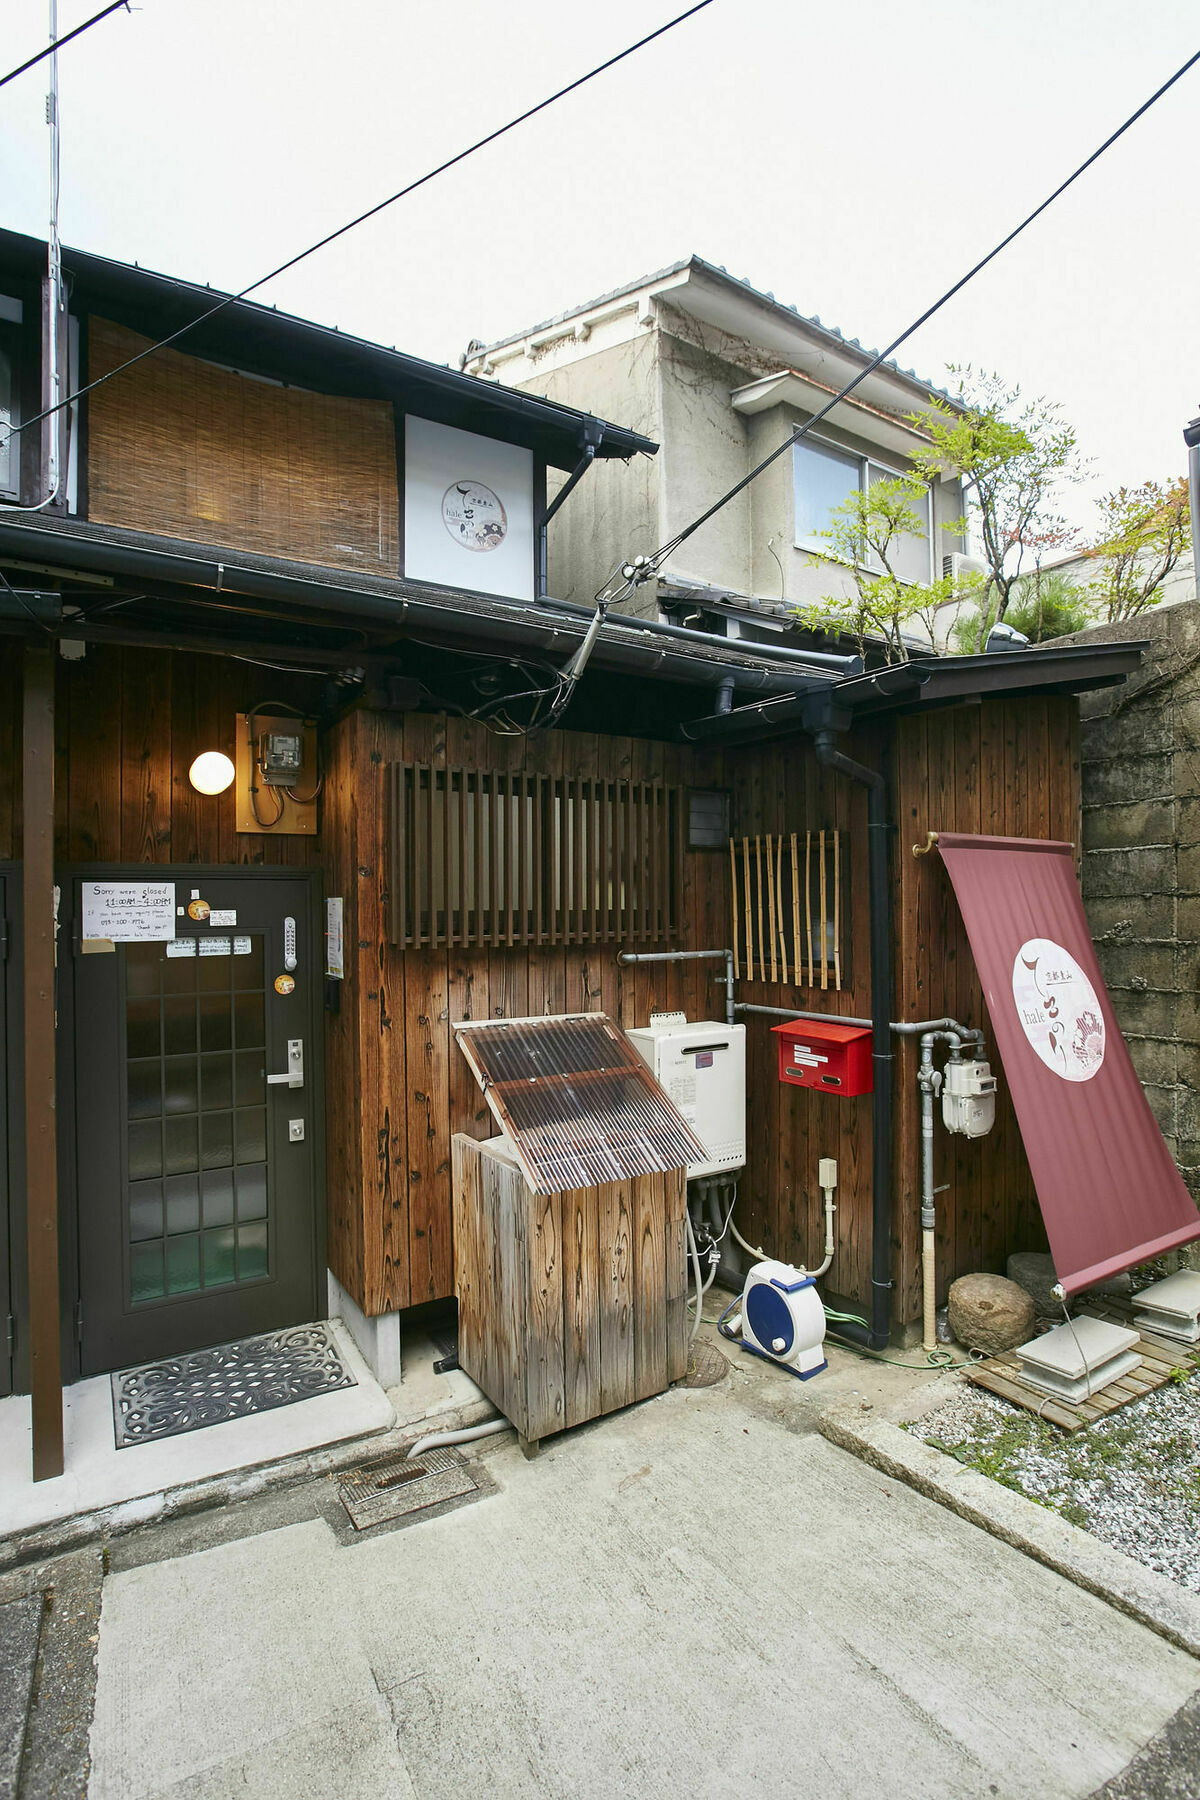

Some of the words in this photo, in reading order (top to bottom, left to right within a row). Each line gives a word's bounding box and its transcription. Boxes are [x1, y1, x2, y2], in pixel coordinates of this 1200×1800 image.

[446, 508, 462, 518] hale
[93, 885, 115, 896] Sorry
[1022, 1008, 1045, 1026] hale
